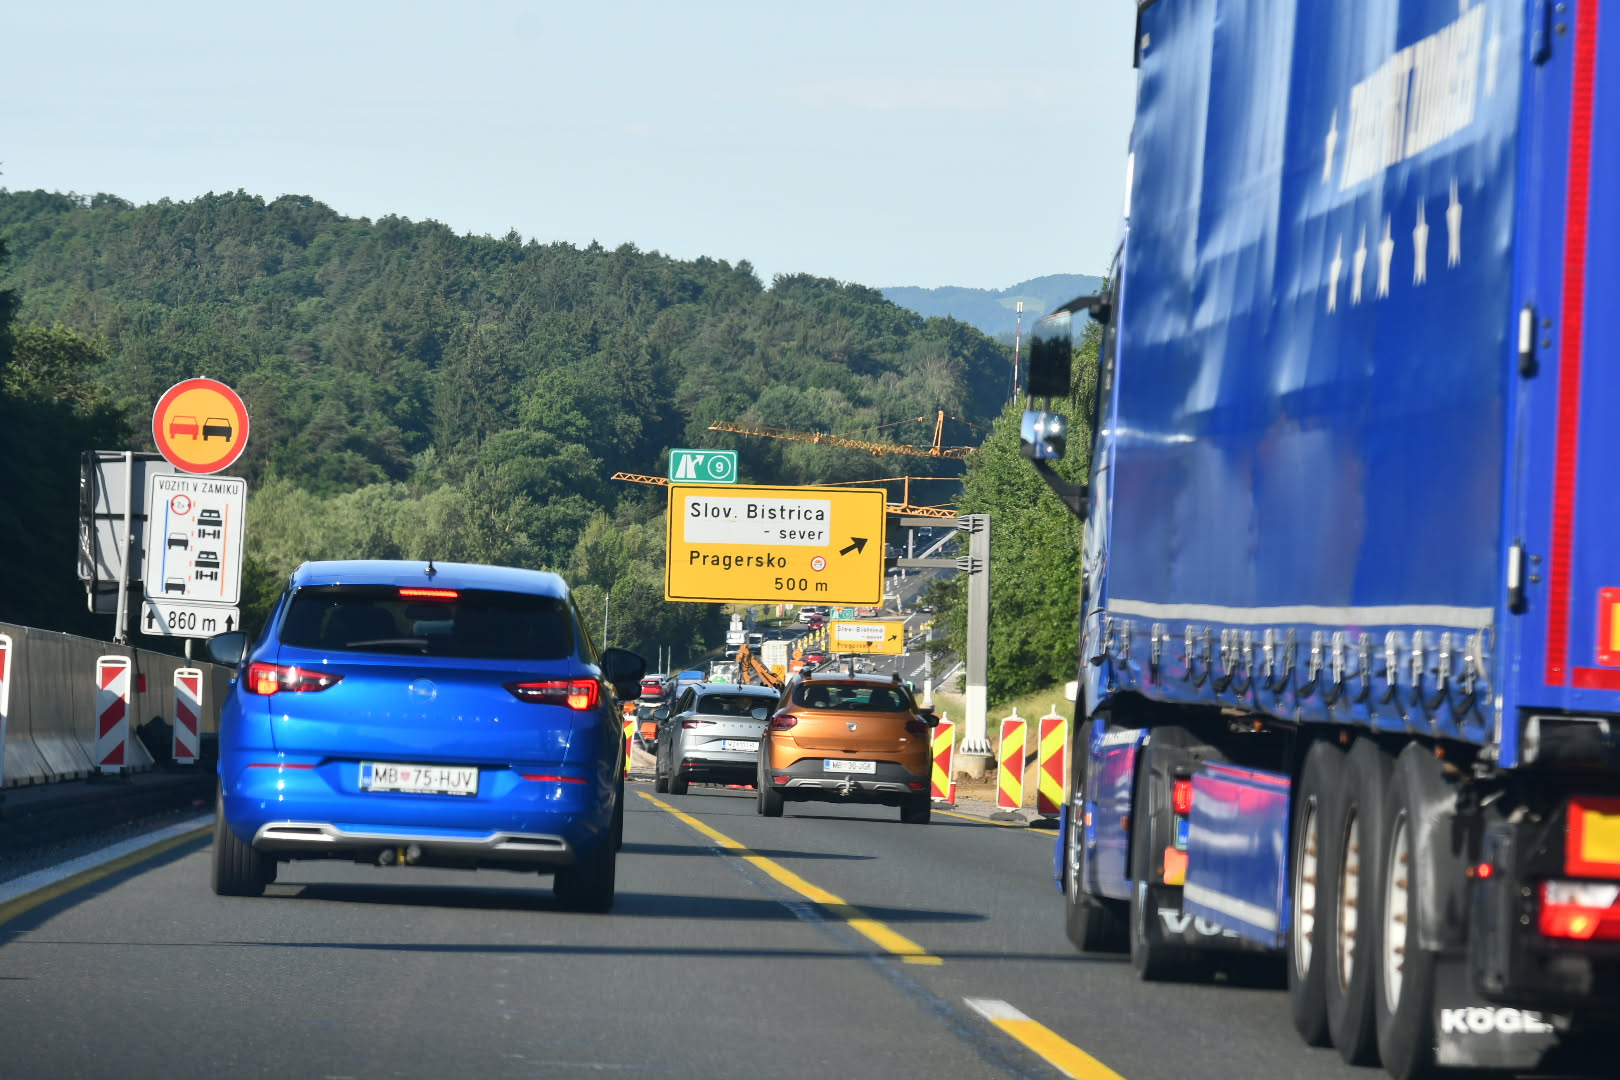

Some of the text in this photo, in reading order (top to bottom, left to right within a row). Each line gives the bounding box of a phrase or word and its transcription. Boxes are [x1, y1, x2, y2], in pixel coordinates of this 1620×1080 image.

[715, 461, 724, 473] 9
[158, 480, 239, 495] VOZITI V ZAMIKU
[690, 502, 825, 521] Slov. Bistrica
[779, 528, 824, 540] sever
[690, 550, 787, 570] Pragersko
[774, 577, 828, 592] 500 m
[168, 611, 216, 632] 860 m
[374, 767, 398, 783] MB
[413, 769, 473, 788] 75-HJV
